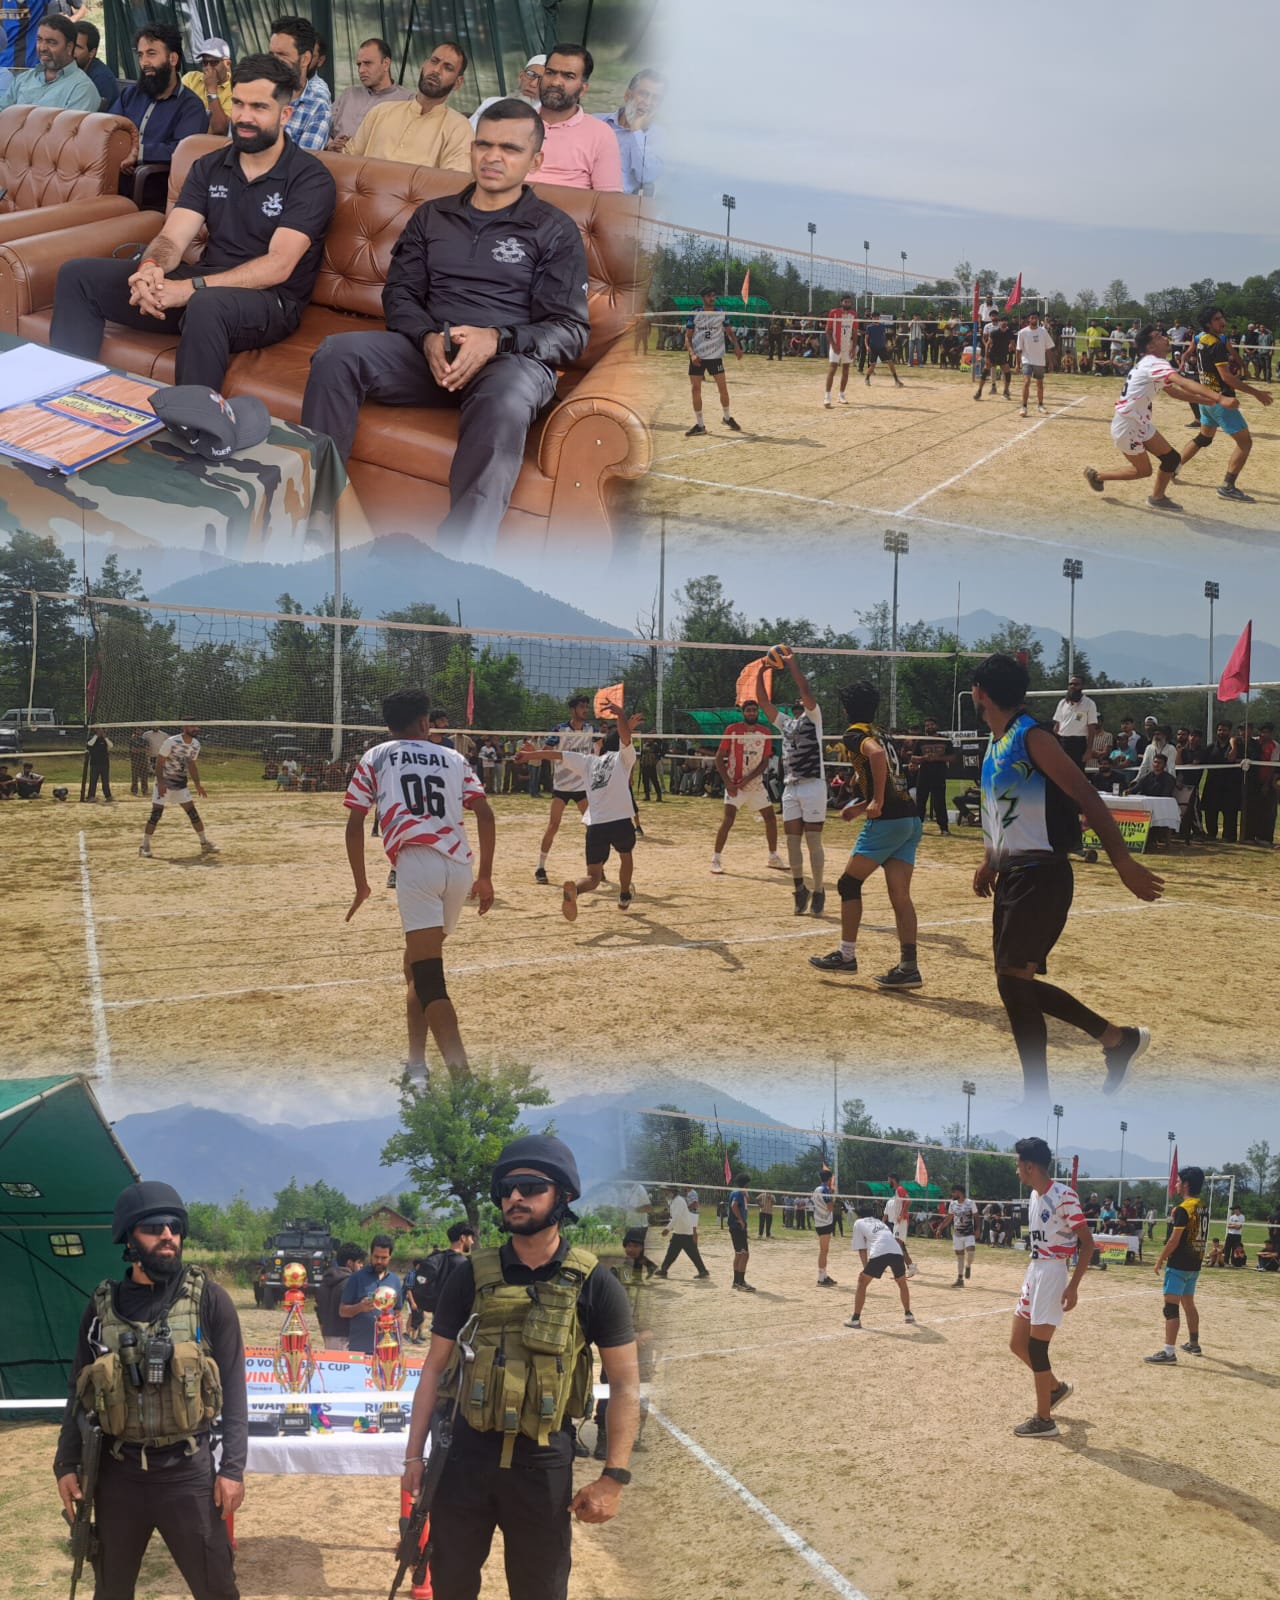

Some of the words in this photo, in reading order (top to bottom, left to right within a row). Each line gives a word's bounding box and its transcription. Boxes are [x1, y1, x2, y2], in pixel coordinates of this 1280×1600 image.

[389, 751, 449, 768] FAISAL
[400, 773, 446, 819] 06
[328, 1363, 350, 1372] CUP
